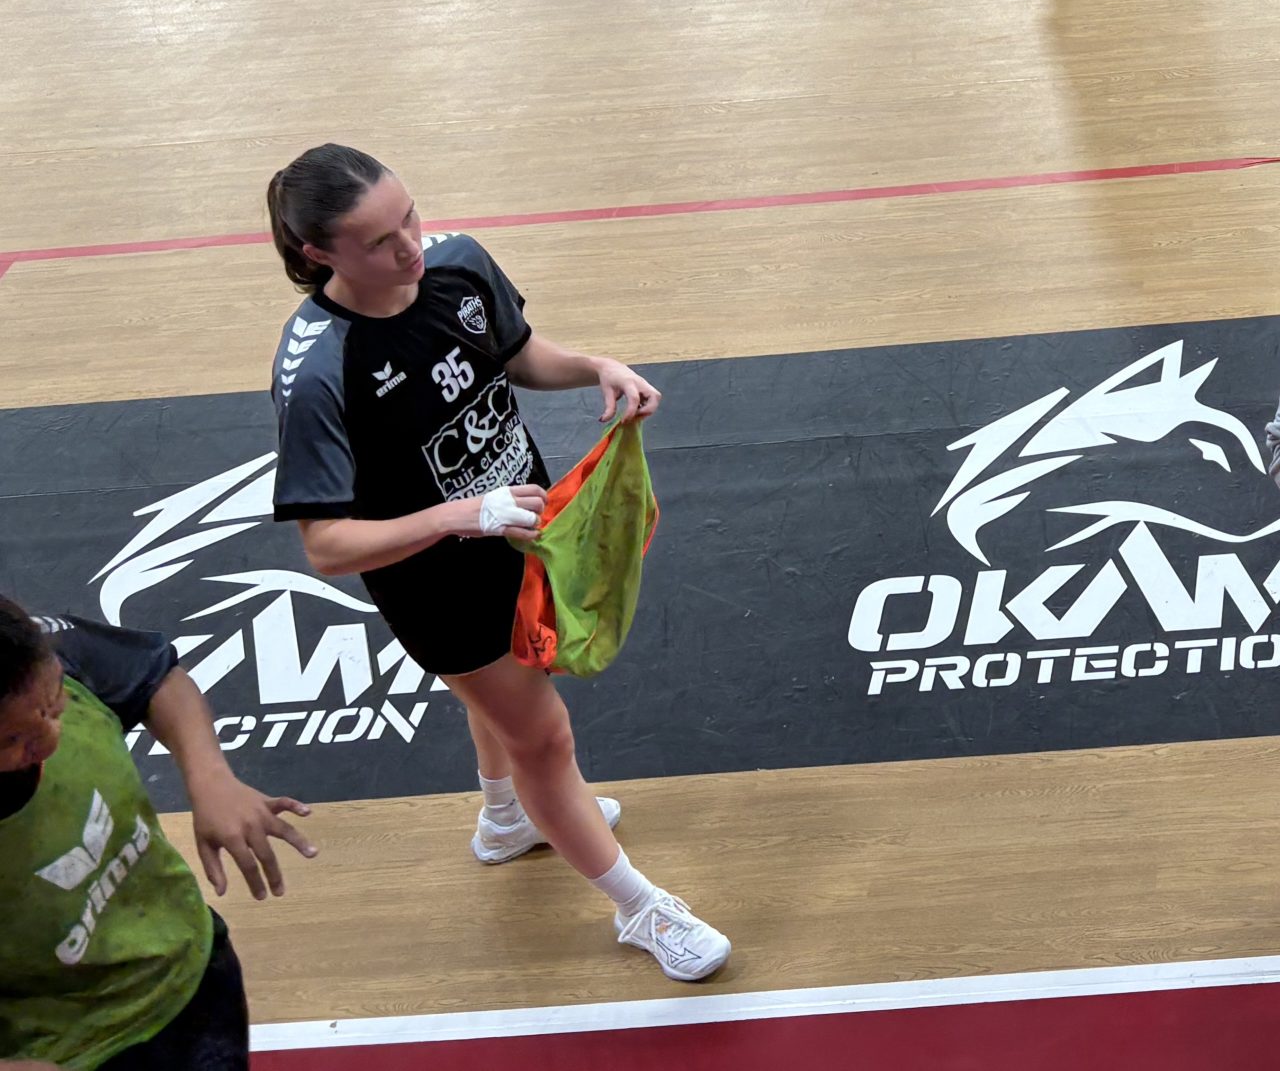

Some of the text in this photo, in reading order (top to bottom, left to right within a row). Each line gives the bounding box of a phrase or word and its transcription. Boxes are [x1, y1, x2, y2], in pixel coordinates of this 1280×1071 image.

[376, 371, 407, 398] erima
[431, 346, 475, 403] 35
[442, 466, 475, 496] Cuir
[480, 451, 493, 470] et
